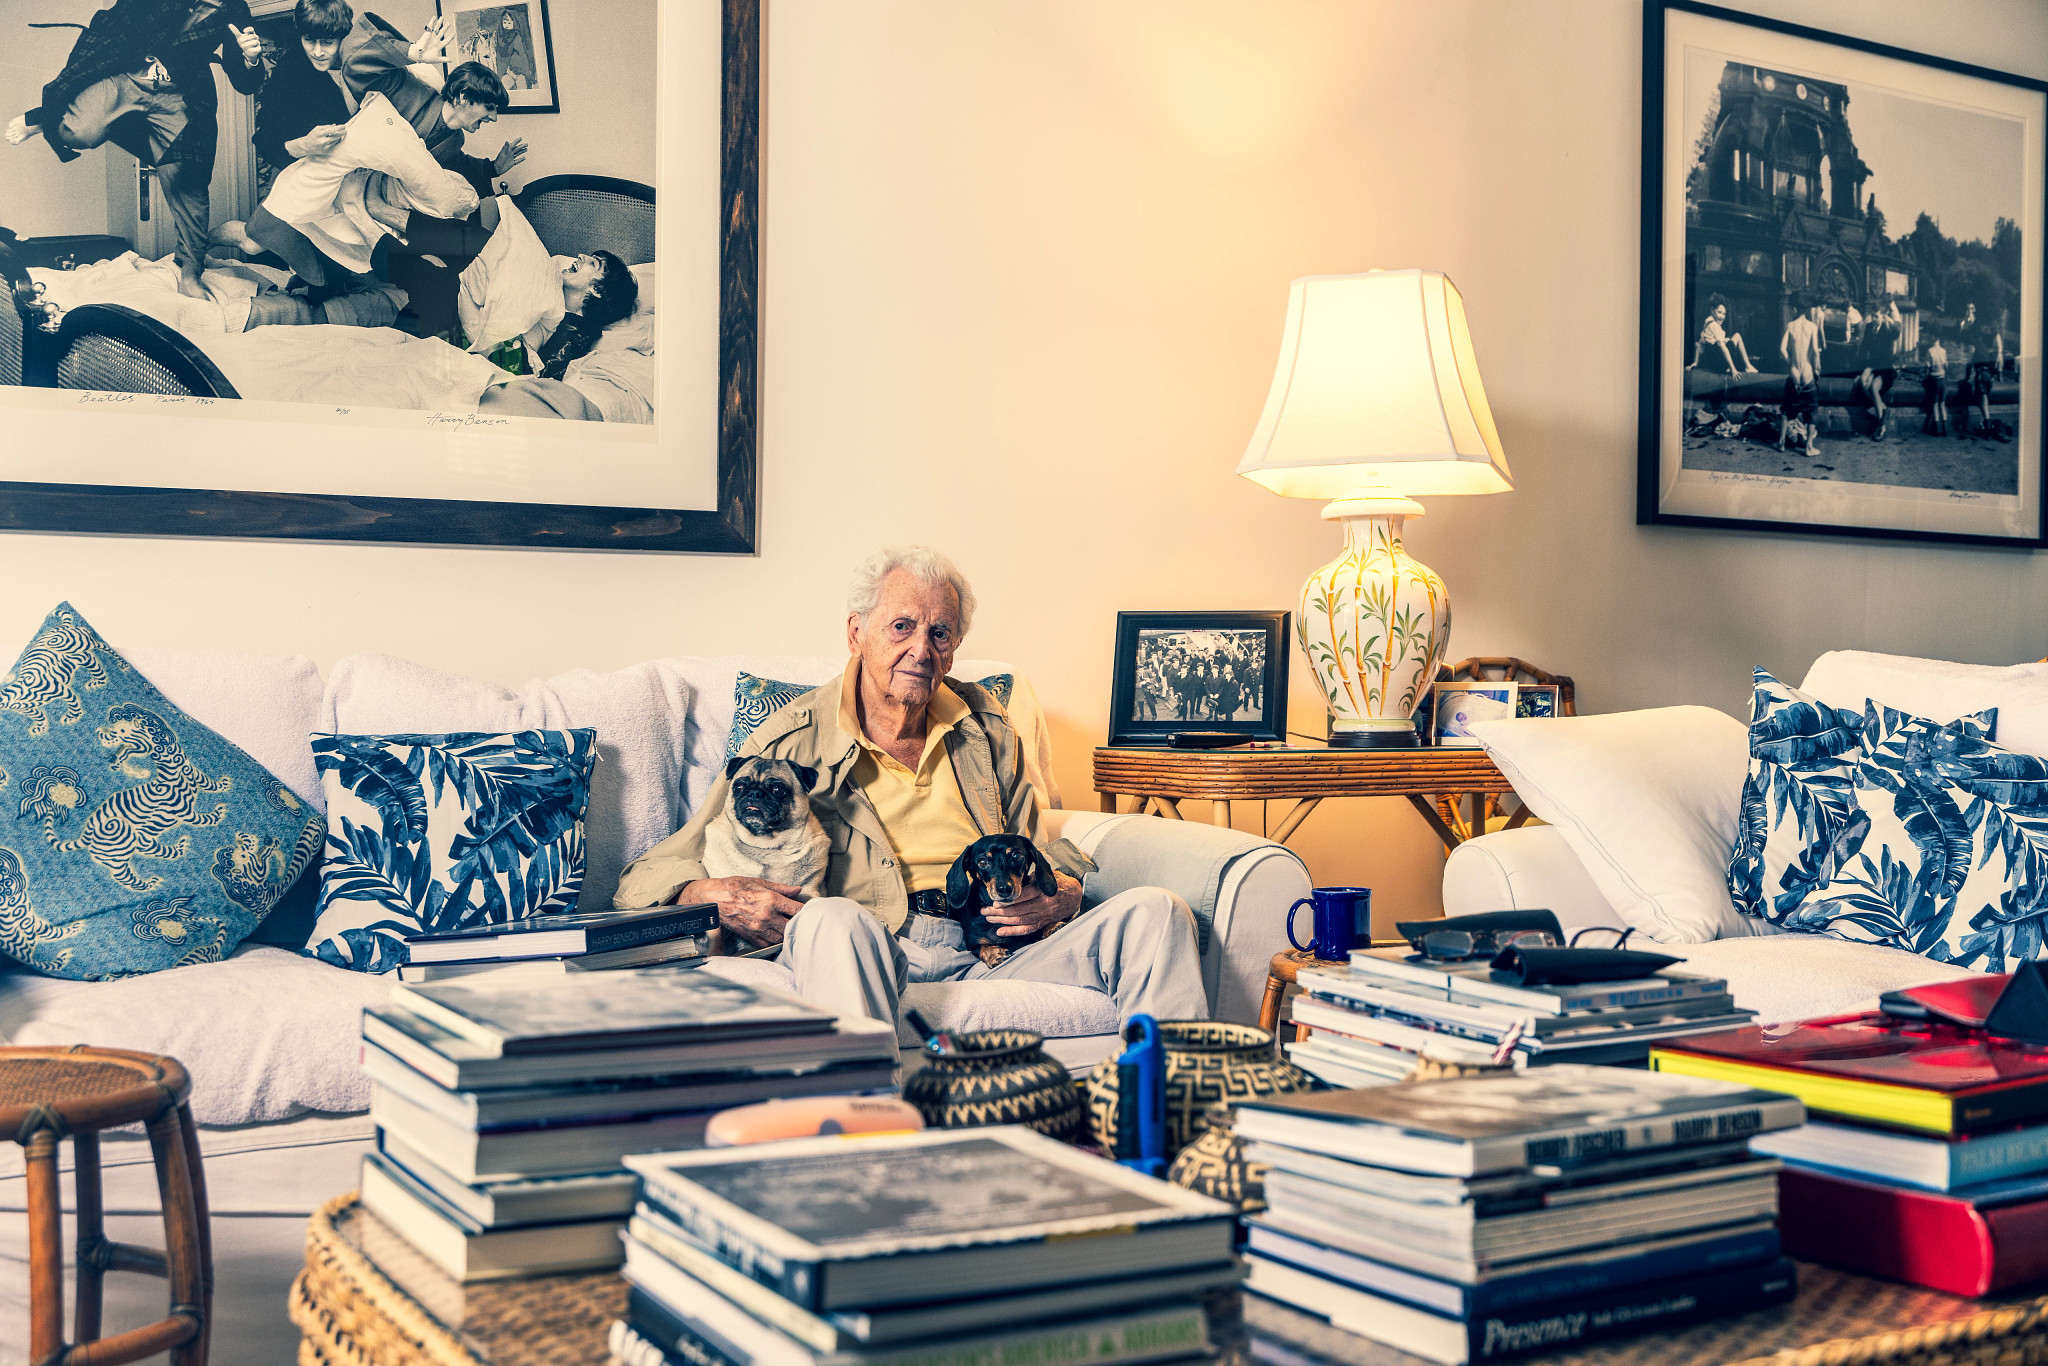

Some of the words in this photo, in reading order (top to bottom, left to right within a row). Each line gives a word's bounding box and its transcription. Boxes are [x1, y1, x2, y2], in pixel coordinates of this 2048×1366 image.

[592, 935, 613, 947] HARRY
[641, 925, 668, 939] PERSONS
[669, 923, 677, 934] OF
[678, 918, 703, 931] INTEREST
[1483, 1310, 1587, 1356] Presence
